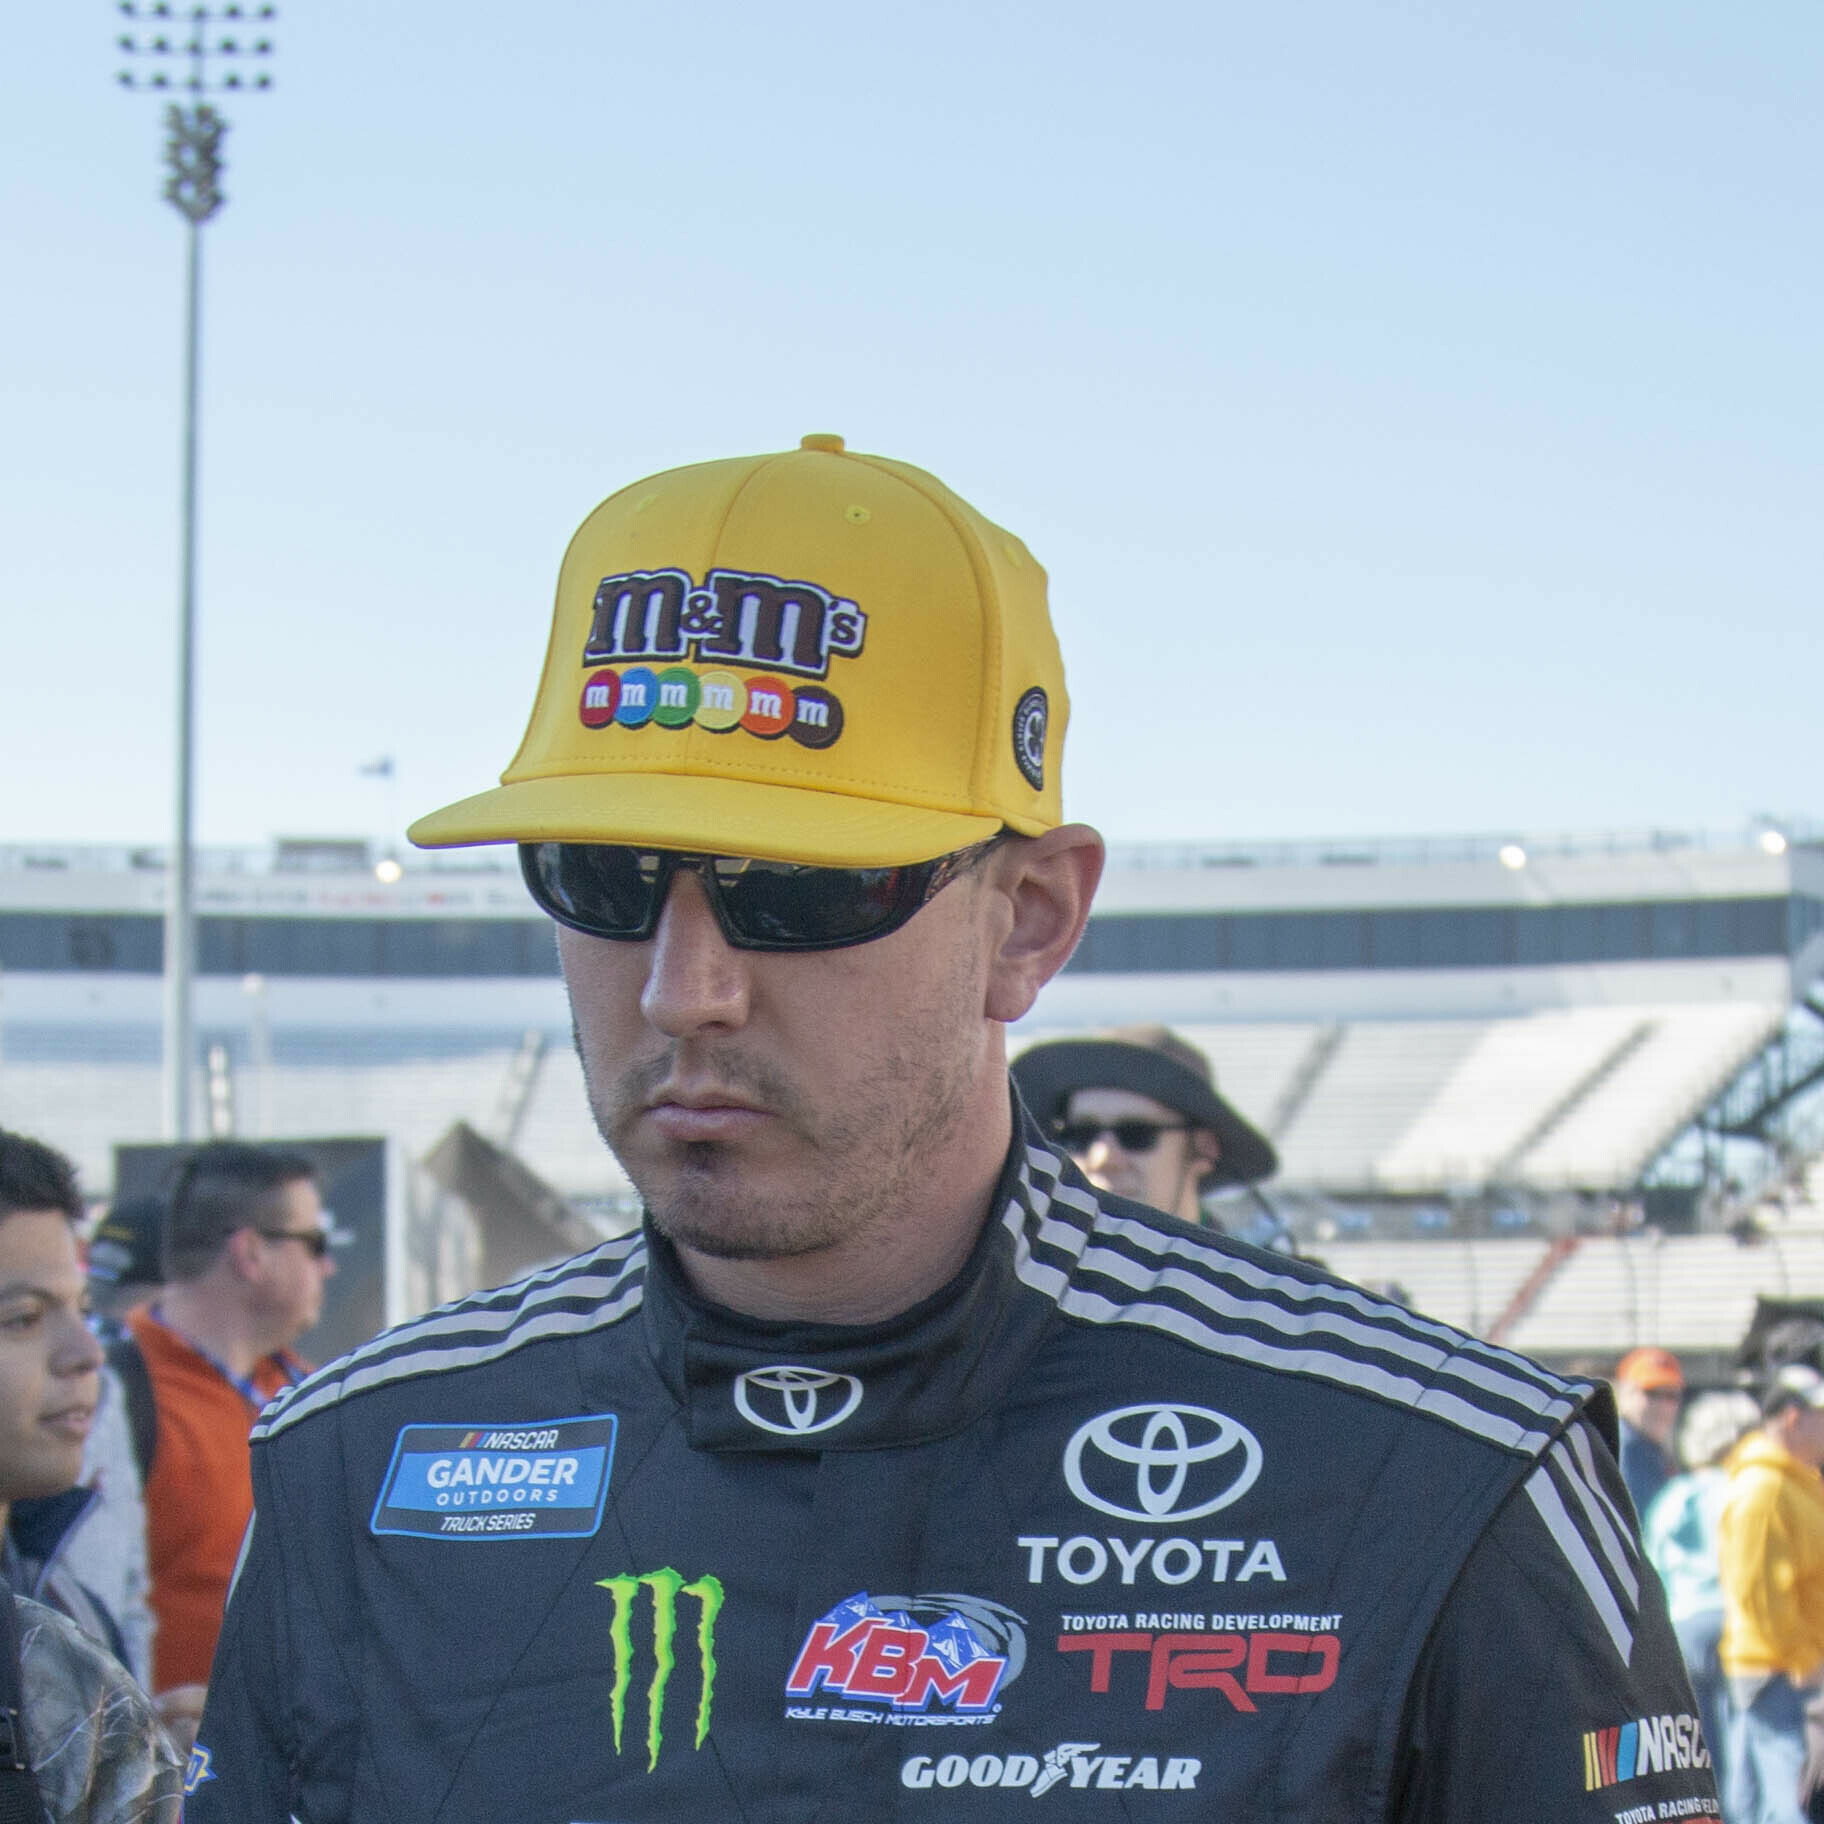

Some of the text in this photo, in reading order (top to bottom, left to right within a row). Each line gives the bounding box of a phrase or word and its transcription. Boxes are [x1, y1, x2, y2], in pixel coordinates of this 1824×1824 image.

[483, 1430, 559, 1450] NASCAR
[427, 1457, 579, 1489] GANDER
[436, 1489, 559, 1506] OUTDOORS
[440, 1513, 537, 1532] TRUCK SERIES
[1018, 1537, 1288, 1585] TOYOTA
[1062, 1613, 1344, 1633] TOYOTA RACING DEVELOPMENT
[786, 1616, 1008, 1713] KBM
[1057, 1633, 1342, 1713] TRD
[785, 1706, 998, 1727] KYLE BUSCH MOTORSPORTS
